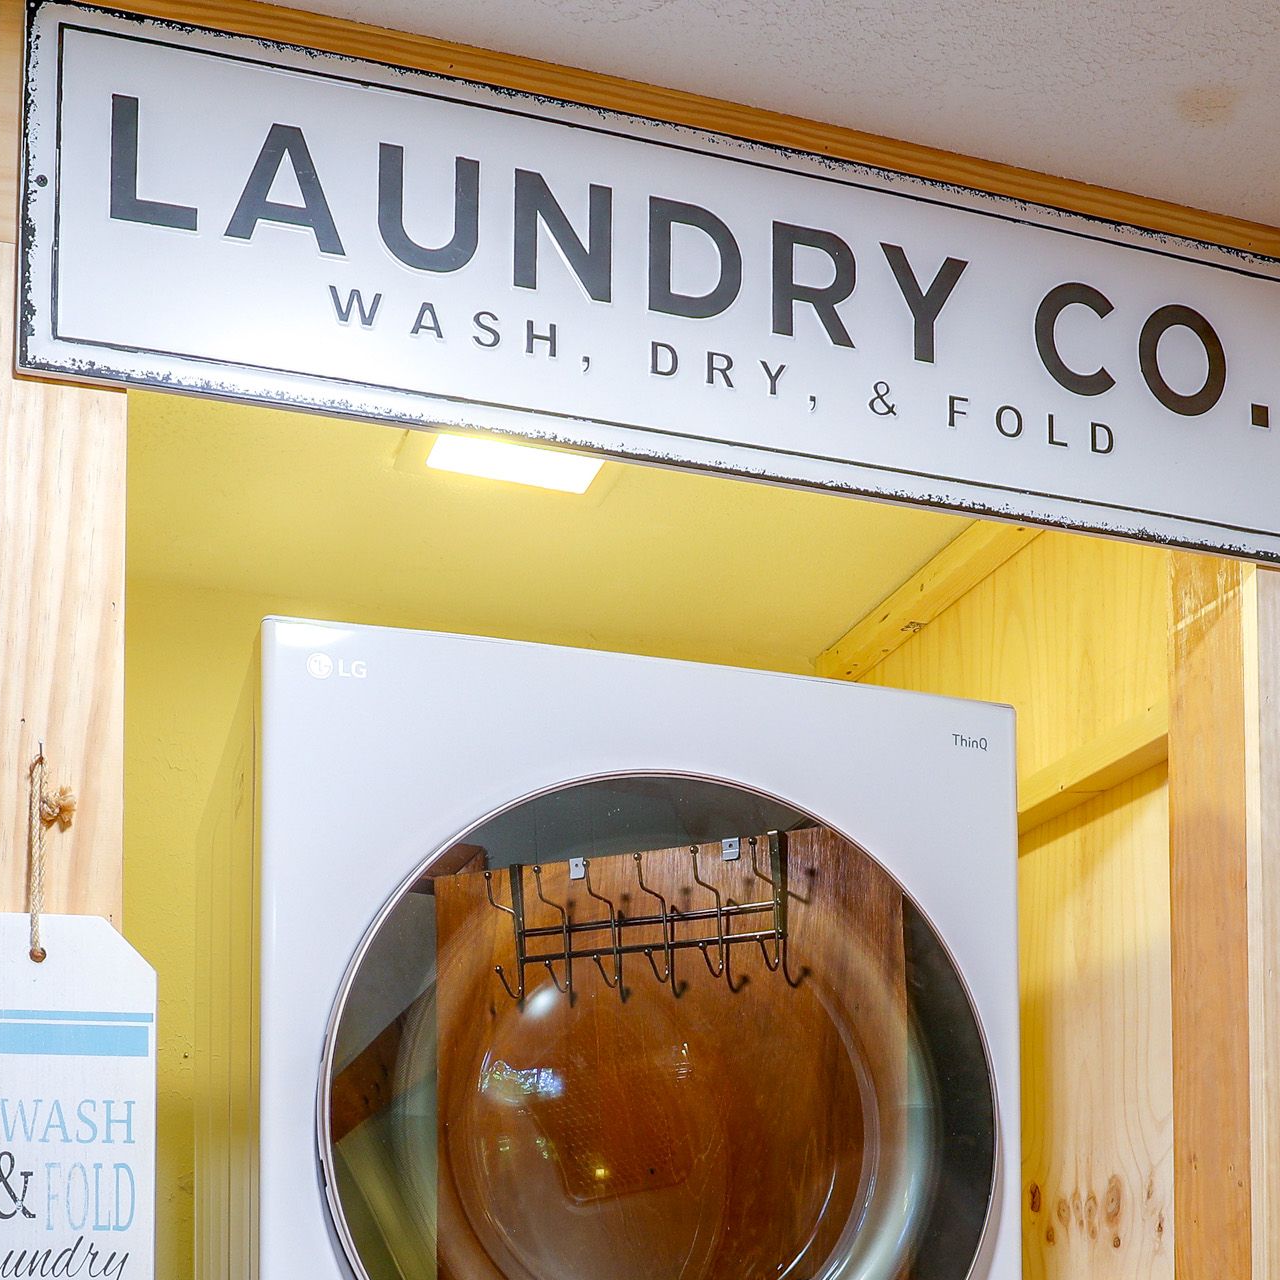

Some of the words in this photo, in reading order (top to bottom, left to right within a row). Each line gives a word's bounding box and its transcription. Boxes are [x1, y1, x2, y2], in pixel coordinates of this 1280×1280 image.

[109, 93, 969, 364] LAUNDRY
[1033, 280, 1270, 429] CO.
[329, 284, 592, 375] WASH,
[650, 341, 818, 412] DRY,
[866, 379, 899, 418] &
[946, 394, 1116, 456] FOLD
[337, 658, 368, 679] LG
[951, 733, 988, 752] ThinQ
[45, 1162, 136, 1232] FOLD
